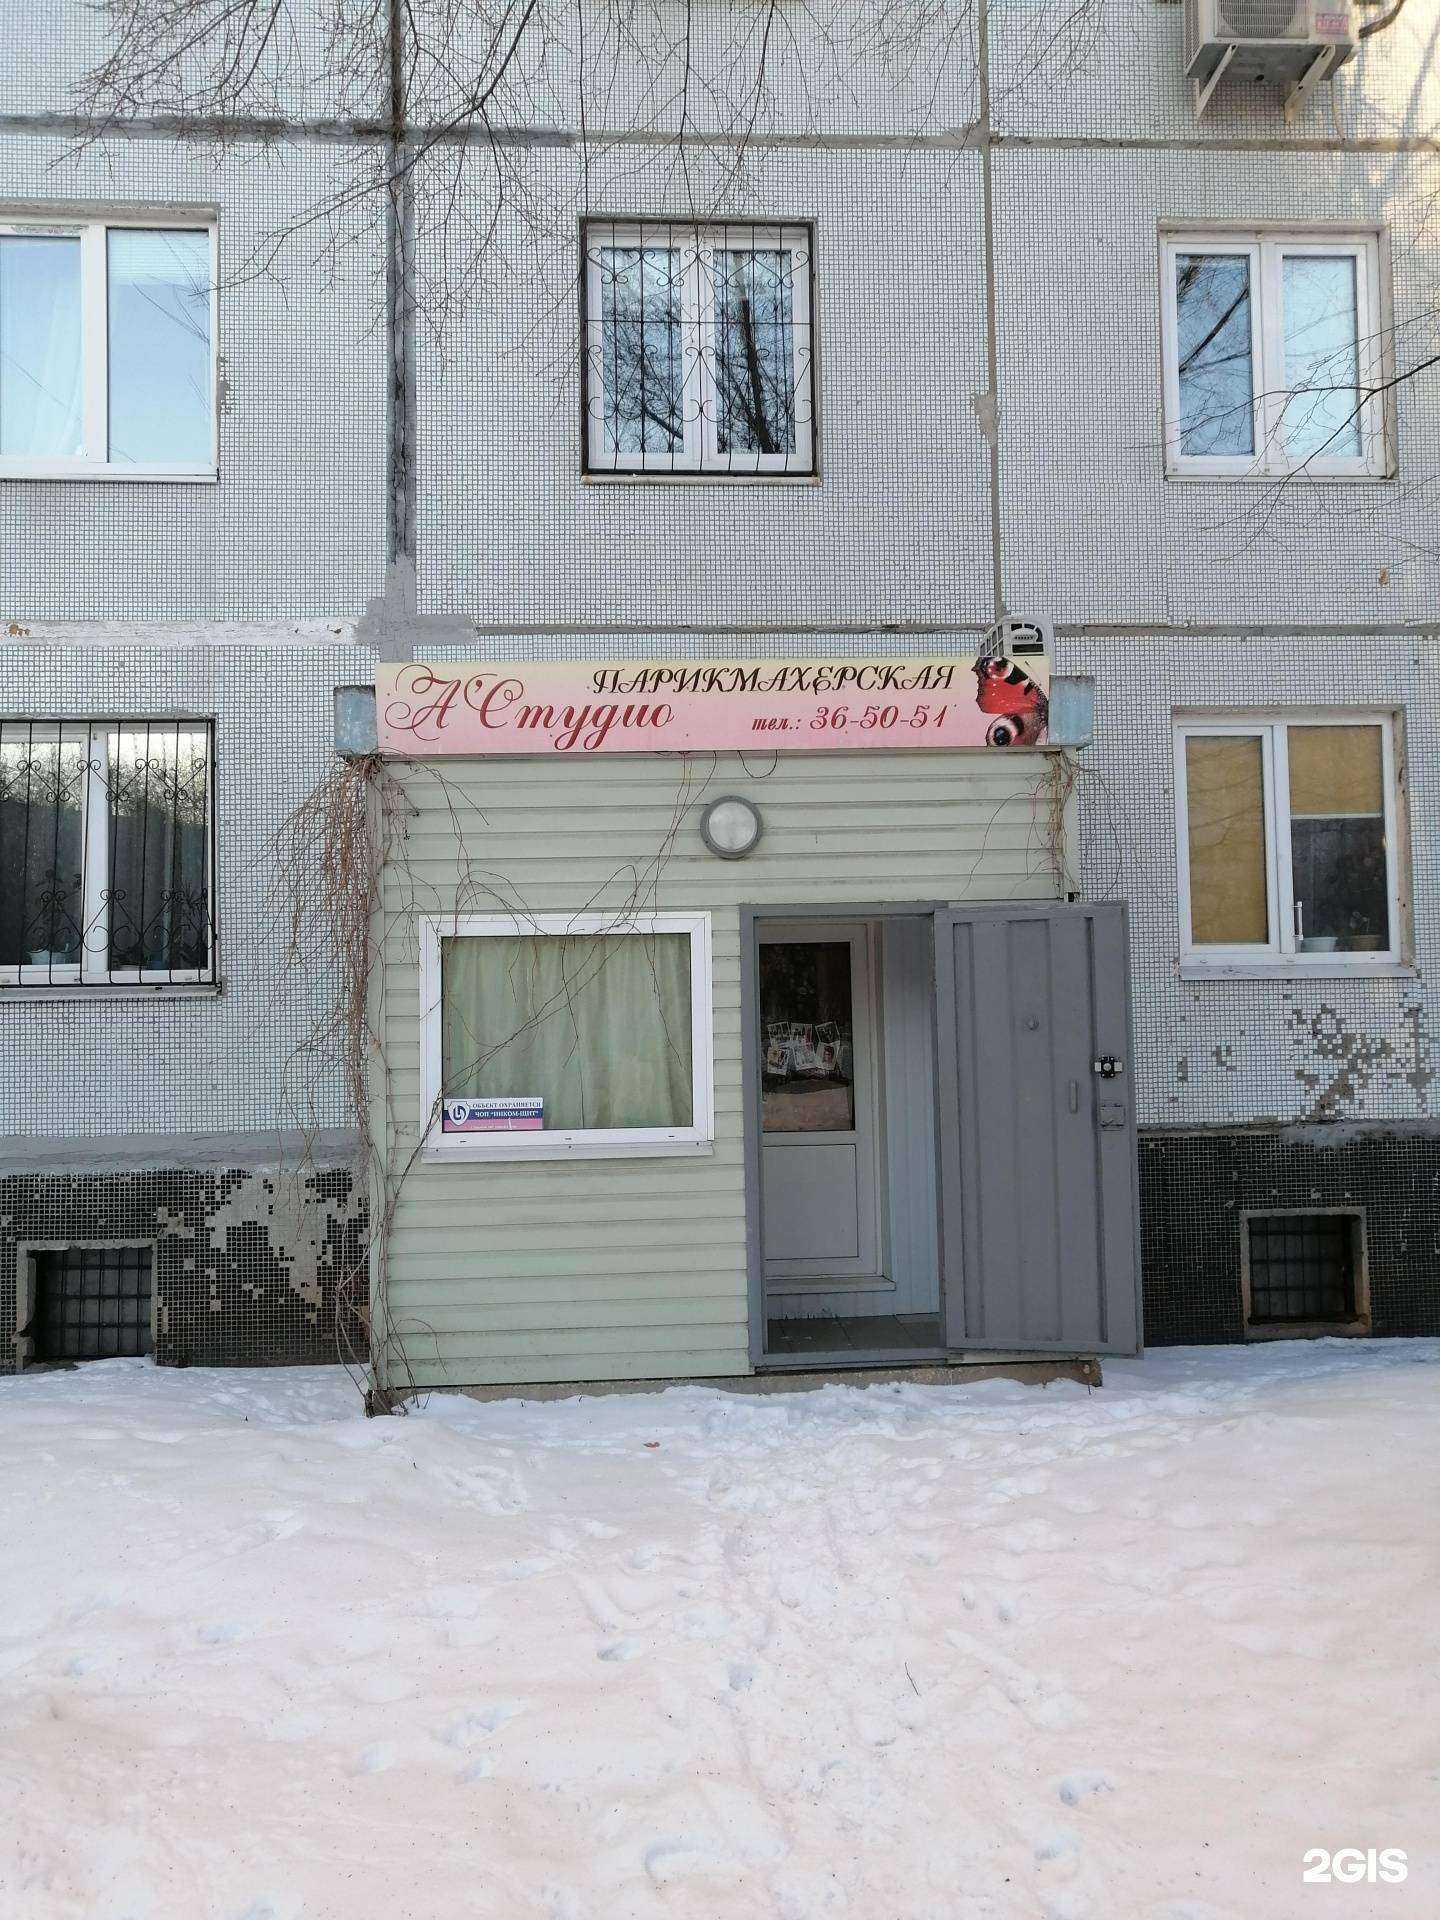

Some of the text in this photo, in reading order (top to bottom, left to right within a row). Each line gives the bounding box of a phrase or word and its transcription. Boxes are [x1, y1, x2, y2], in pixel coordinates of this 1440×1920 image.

[593, 665, 955, 695] ПАРИКМАХЕРСКАЯ
[751, 704, 949, 731] тел.: 36-50-51
